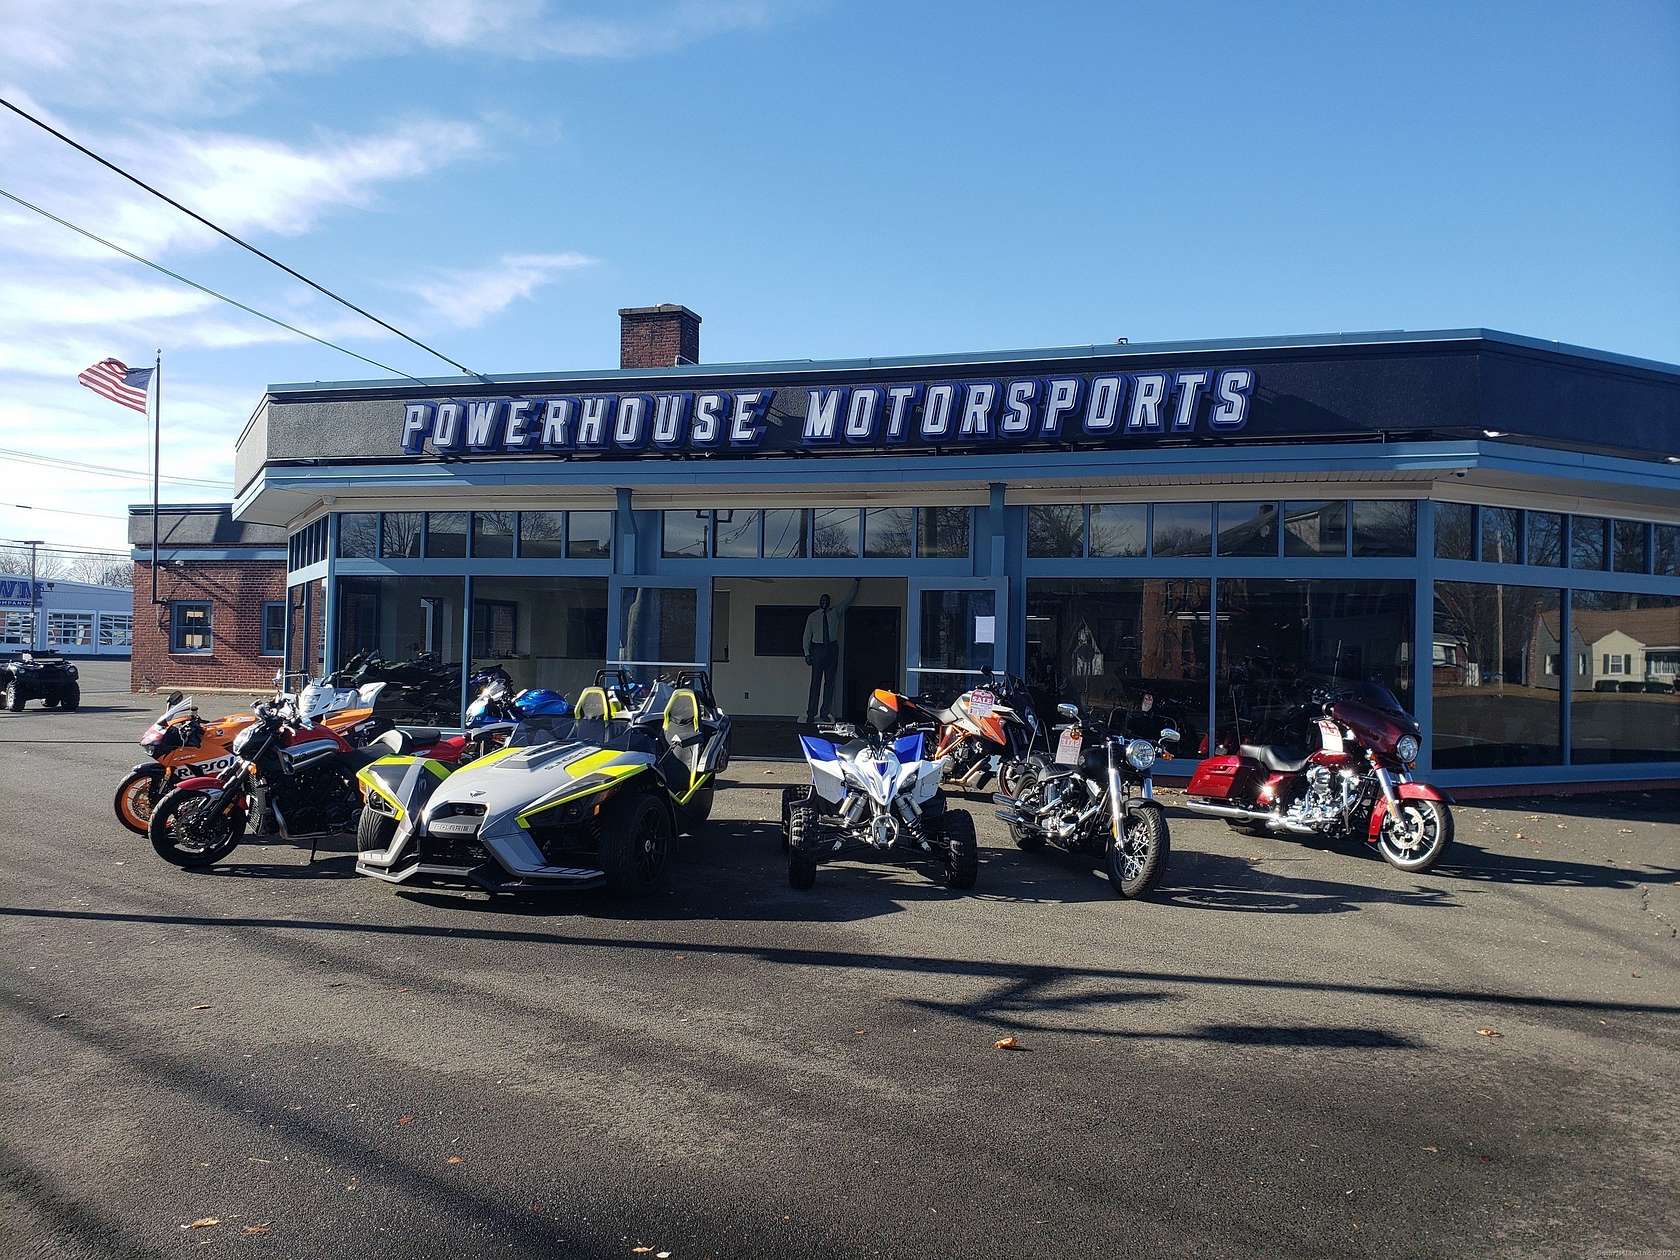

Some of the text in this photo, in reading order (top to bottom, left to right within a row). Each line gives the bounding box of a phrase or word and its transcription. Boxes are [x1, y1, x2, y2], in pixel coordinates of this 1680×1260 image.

[400, 369, 1255, 452] POWERHOUSE MOTORSPORTS
[972, 695, 992, 705] SALE
[178, 756, 235, 776] RPSOL
